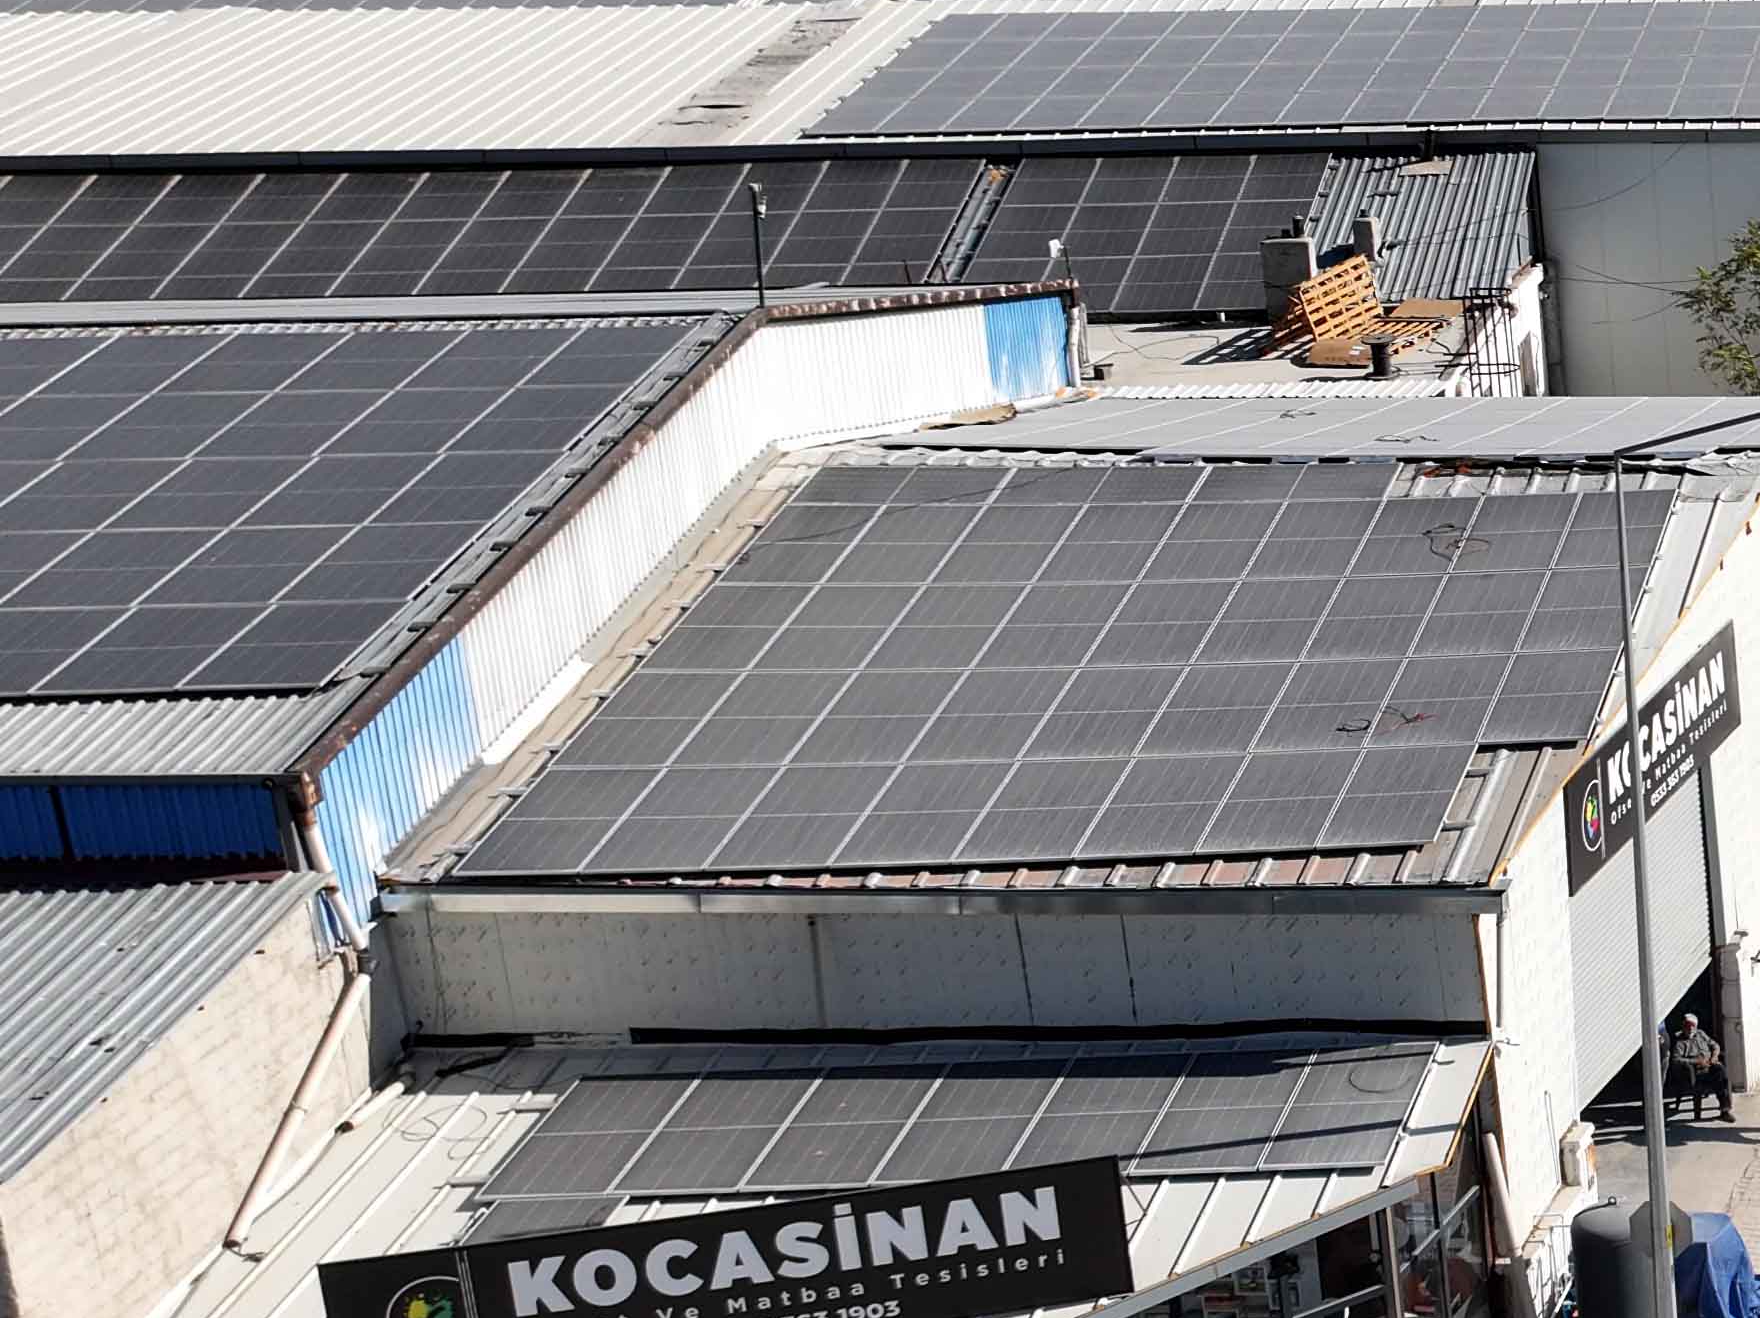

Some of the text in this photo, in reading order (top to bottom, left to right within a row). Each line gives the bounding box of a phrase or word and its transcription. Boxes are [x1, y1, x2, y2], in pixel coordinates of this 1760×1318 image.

[507, 1185, 1063, 1318] KOCASİNAN
[726, 1280, 866, 1316] Matbaa
[889, 1248, 1067, 1290] Tesisleri
